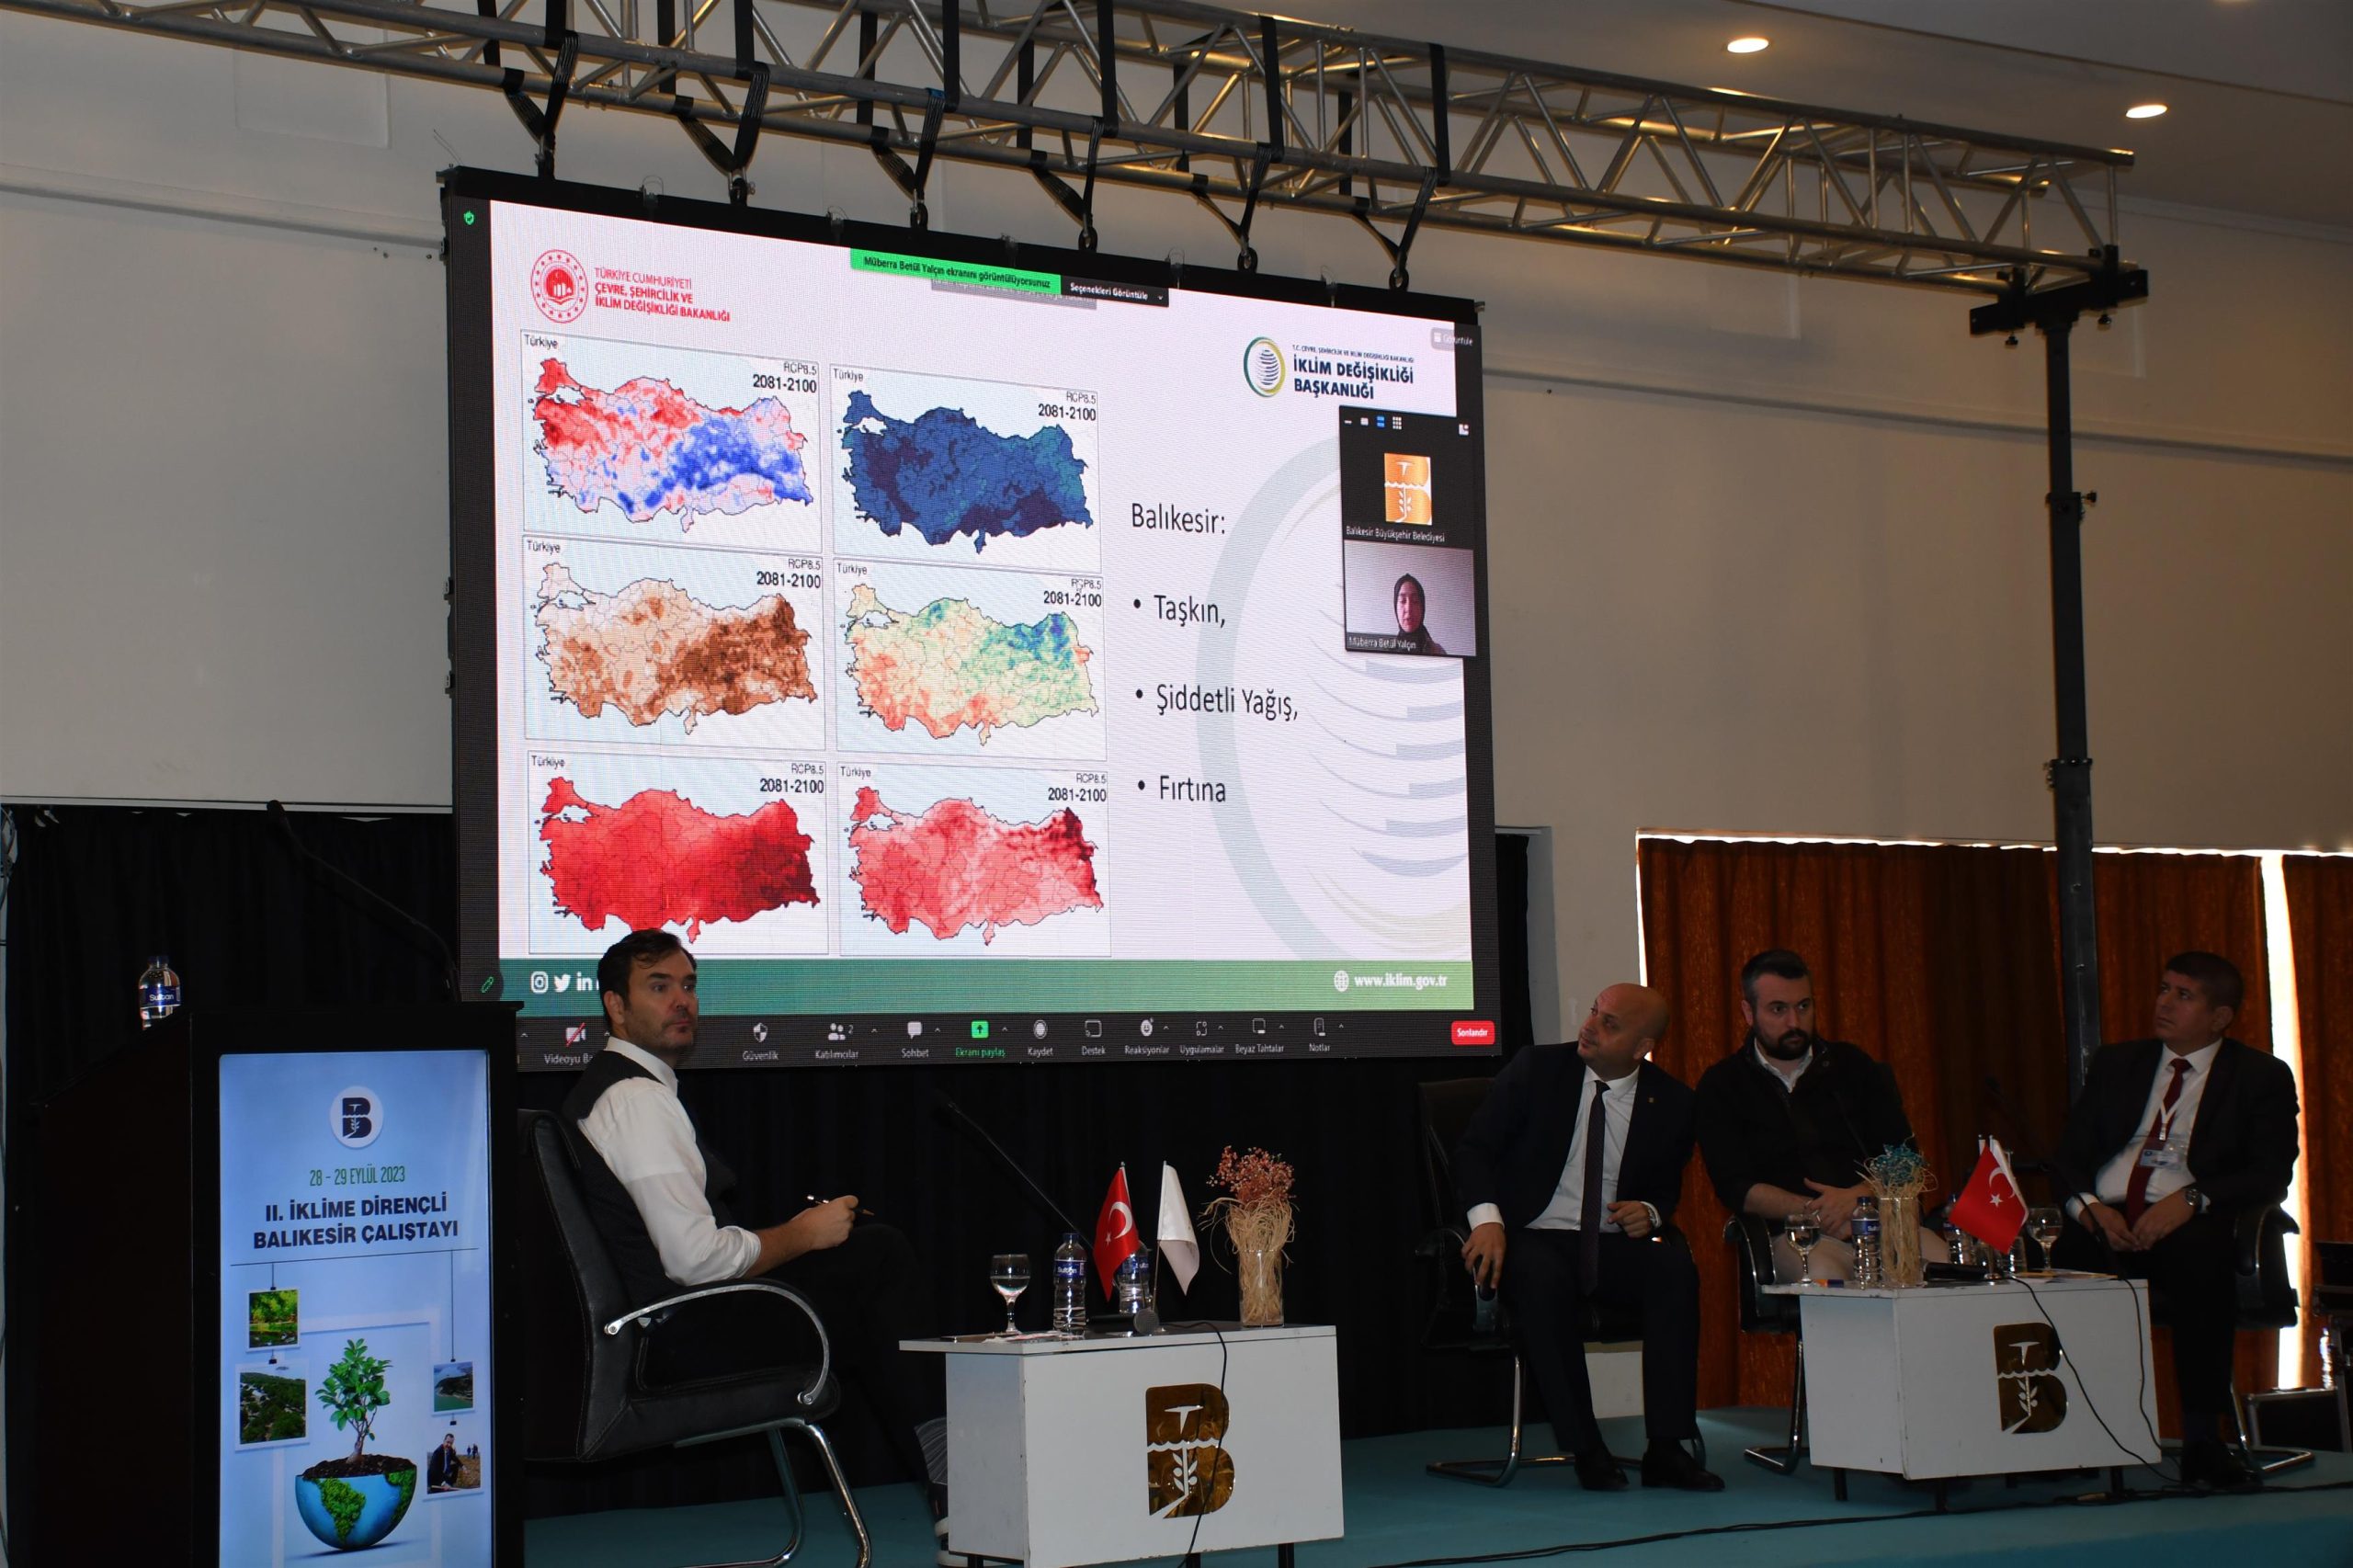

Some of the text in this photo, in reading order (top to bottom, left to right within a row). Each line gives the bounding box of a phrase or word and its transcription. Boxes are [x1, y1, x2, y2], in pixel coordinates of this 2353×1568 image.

[595, 267, 692, 290] TÜRKİYE CUMHURİYETİ
[630, 285, 679, 302] ŞEHİRCİLİK
[681, 292, 693, 304] VE
[595, 294, 621, 309] İKLİM
[680, 306, 731, 322] BAKANLIĞI
[524, 335, 559, 349] Türkiye
[833, 368, 864, 382] Türkiye
[1293, 354, 1415, 384] İKLİM DEĞİŞİKLİĞİ
[753, 373, 818, 393] 2081-2100
[1294, 378, 1374, 400] BAŞKANLIĞI
[1038, 403, 1097, 422] 2081-2100
[1131, 503, 1226, 535] Balıkesir:
[527, 540, 561, 555] Türkiye
[837, 563, 868, 576] Türkiye
[756, 570, 822, 589] 2081-2100
[1043, 590, 1102, 608] 2081-2100
[1154, 594, 1226, 629] Taşkın,
[1156, 683, 1299, 722] Şiddetli Yağış,
[531, 755, 566, 767] Türkiye
[840, 766, 871, 779] Türkiye
[759, 778, 824, 794] 2081-2100
[1048, 787, 1107, 802] 2081-2100
[1159, 774, 1227, 803] Fırtına
[1354, 972, 1449, 991] www.iklim.gov.tr
[814, 1048, 859, 1060] Katılımcılar
[901, 1047, 929, 1059] Sohbet
[1028, 1046, 1053, 1058] Kaydet
[1081, 1044, 1106, 1056] Destek
[1124, 1044, 1170, 1056] Reaksiyonlar
[1179, 1044, 1224, 1055] Uygulamalar
[1309, 1042, 1331, 1052] Notlar
[544, 1053, 581, 1067] Videoyu
[742, 1050, 779, 1062] Güvenlik
[309, 1169, 323, 1187] 28
[334, 1167, 347, 1186] 29
[349, 1163, 379, 1185] EYLÜL
[381, 1165, 405, 1184] 2023
[266, 1190, 448, 1222] II. İKLİME DİRENÇLİ
[254, 1220, 459, 1250] BALIKESİR ÇALIŞTAYI
